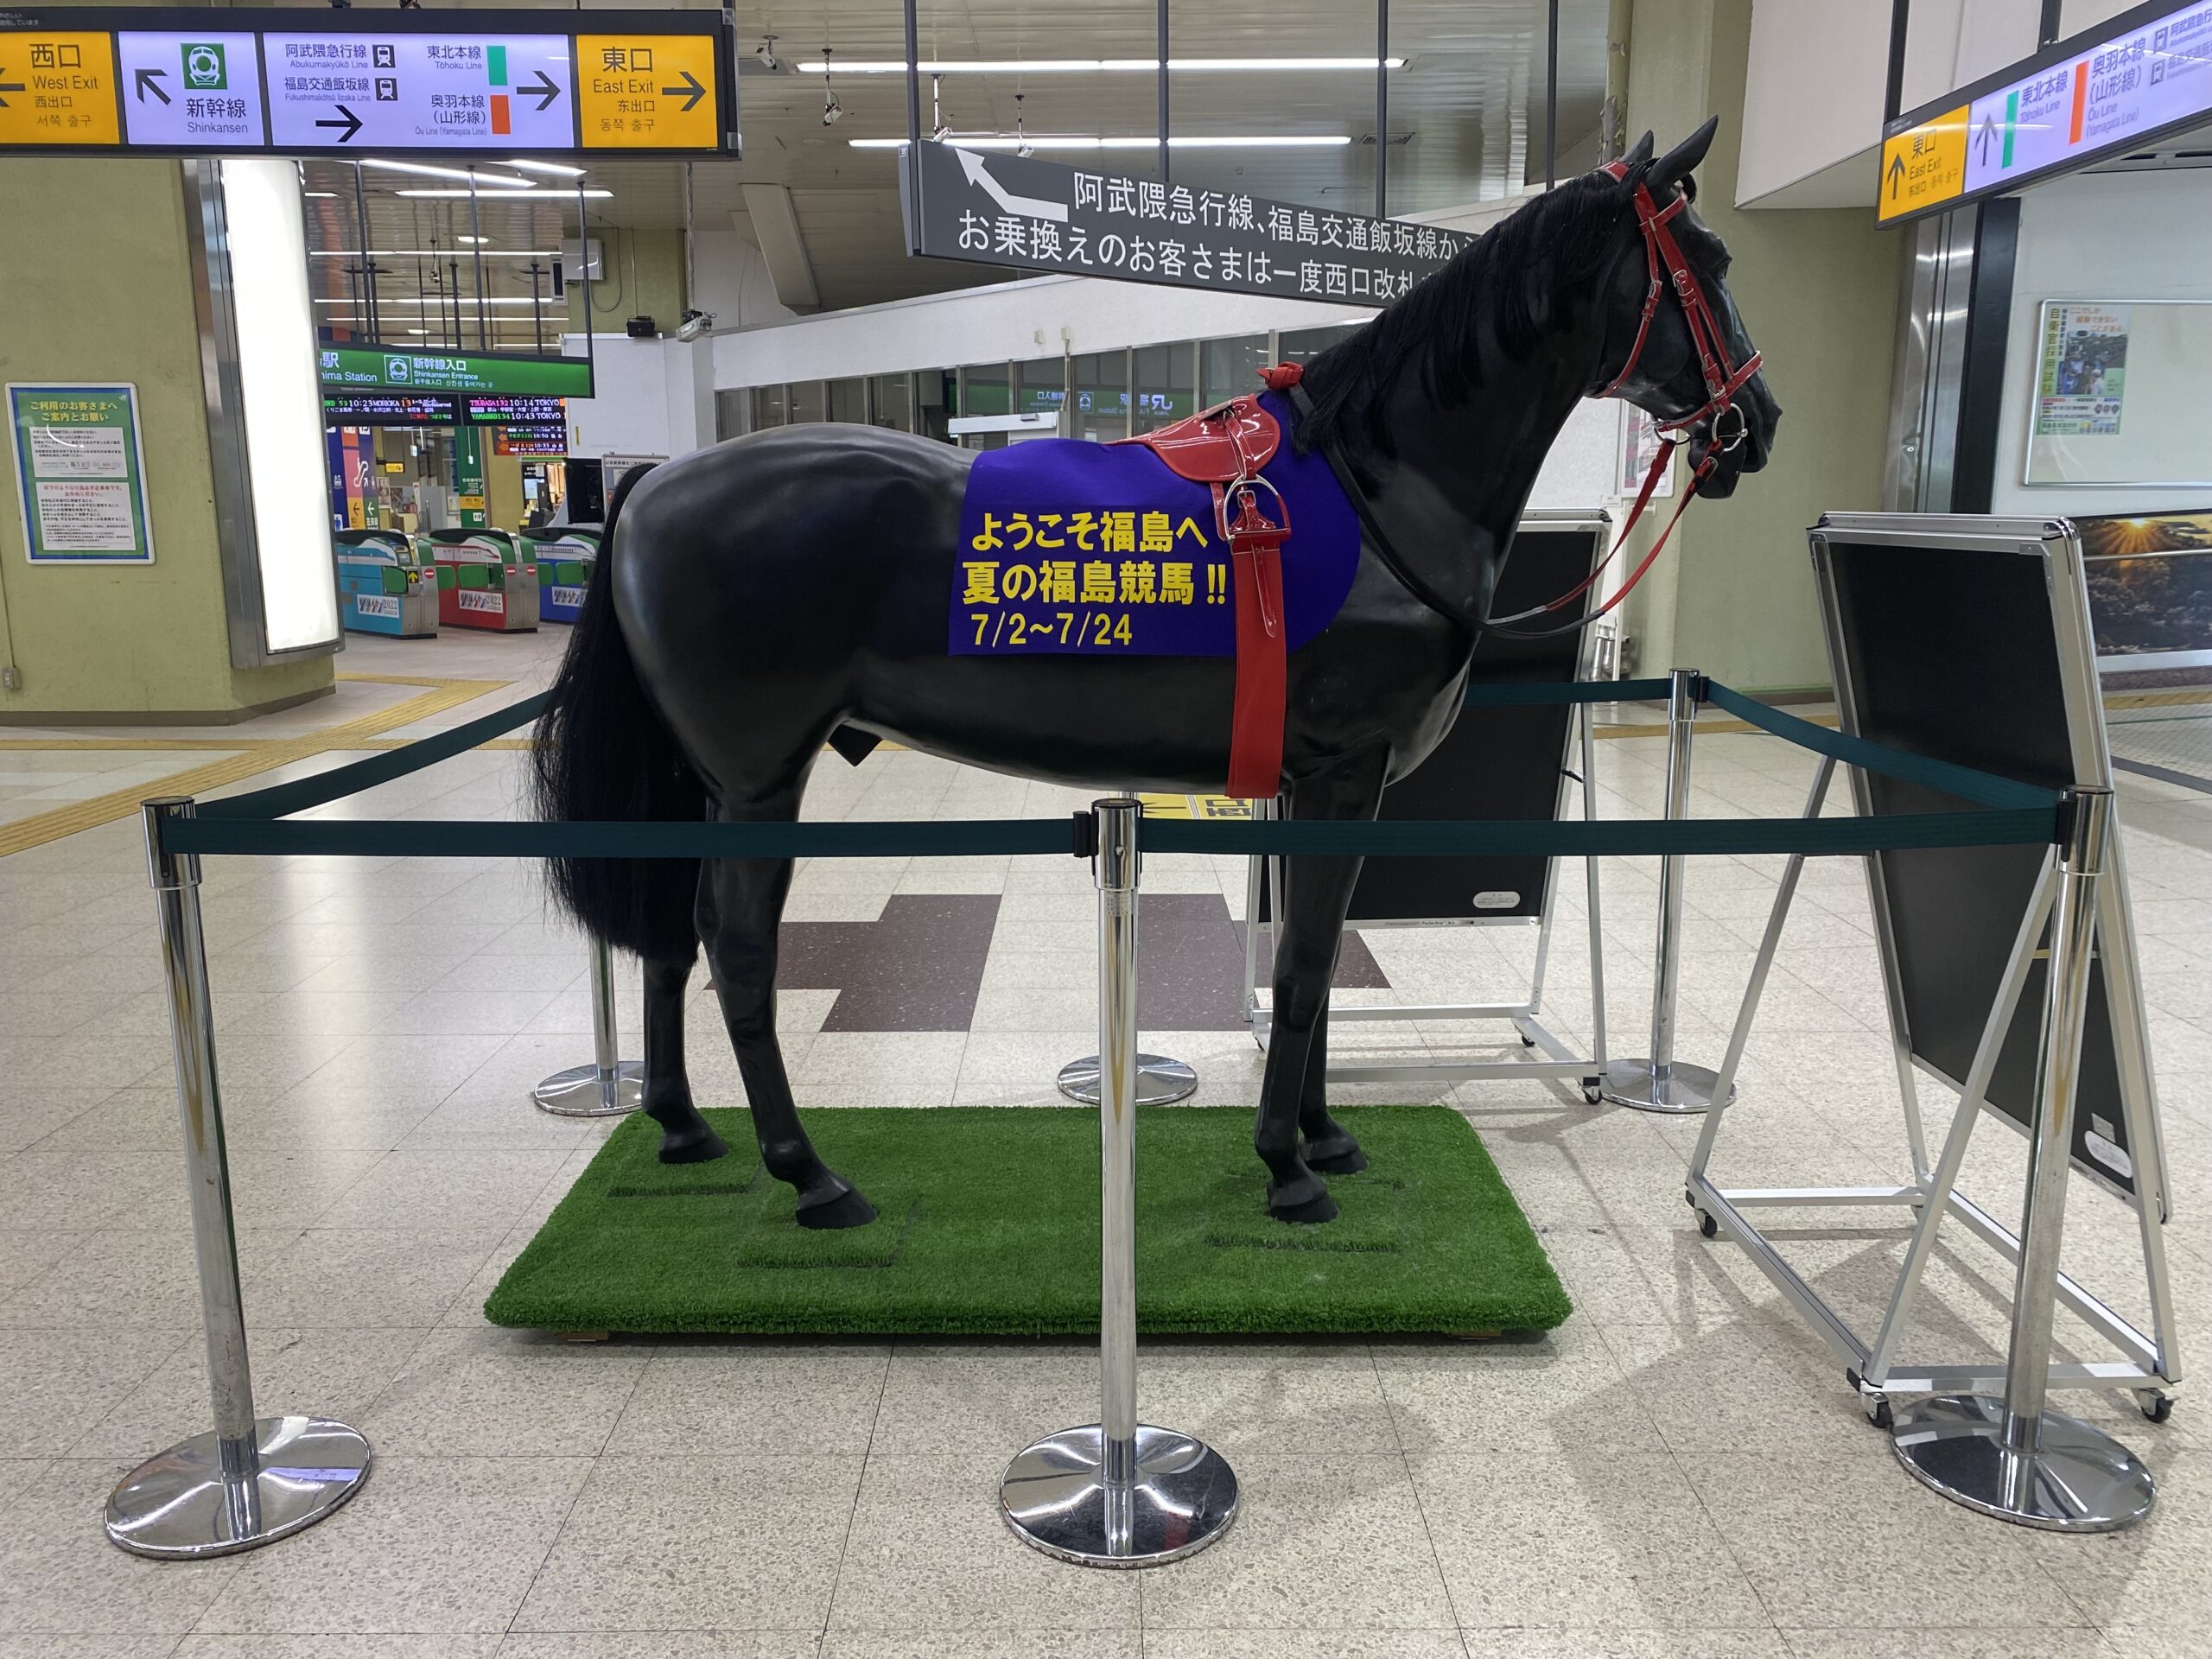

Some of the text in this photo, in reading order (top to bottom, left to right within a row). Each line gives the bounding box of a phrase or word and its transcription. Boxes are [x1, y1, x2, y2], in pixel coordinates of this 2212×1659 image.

[30, 43, 81, 69] 西口
[285, 43, 367, 58] 阿武隈急行線
[427, 45, 481, 60] 東北本線
[2092, 37, 2145, 79] 奥羽本線
[352, 60, 368, 69] Line
[435, 60, 482, 71] Tōhoku Line
[602, 48, 653, 73] 東口
[32, 75, 98, 90] West Exit
[284, 76, 370, 91] 福島交通飯坂線
[594, 79, 654, 93] East Exit
[2021, 70, 2069, 107] 東北本線
[35, 96, 73, 109] 西出口
[357, 93, 371, 102] Line
[431, 94, 485, 108] 奥羽本線
[186, 99, 247, 118] 新幹線
[618, 99, 655, 112] 东出口
[2045, 99, 2060, 117] Line
[2101, 102, 2117, 117] Line
[36, 114, 92, 128] 서쪽 출구
[187, 122, 248, 134] Shinkansen
[600, 118, 656, 132] 동쪽 출구
[472, 127, 487, 136] Line)
[1911, 129, 1936, 159] 東口
[1910, 156, 1942, 180] East Exit
[1074, 172, 1474, 261] 阿武隈急行線、福島交通飯坂線か
[958, 209, 1433, 300] お乗換えのお客さまは一度西口改札
[321, 351, 467, 372] 駅 新幹線入口
[344, 372, 378, 382] Station
[30, 401, 118, 410] ご利用のお客さまへ
[41, 412, 109, 422] ご案内とお願い
[971, 511, 1209, 552] ようこそ福島へ
[486, 595, 501, 605] 2022
